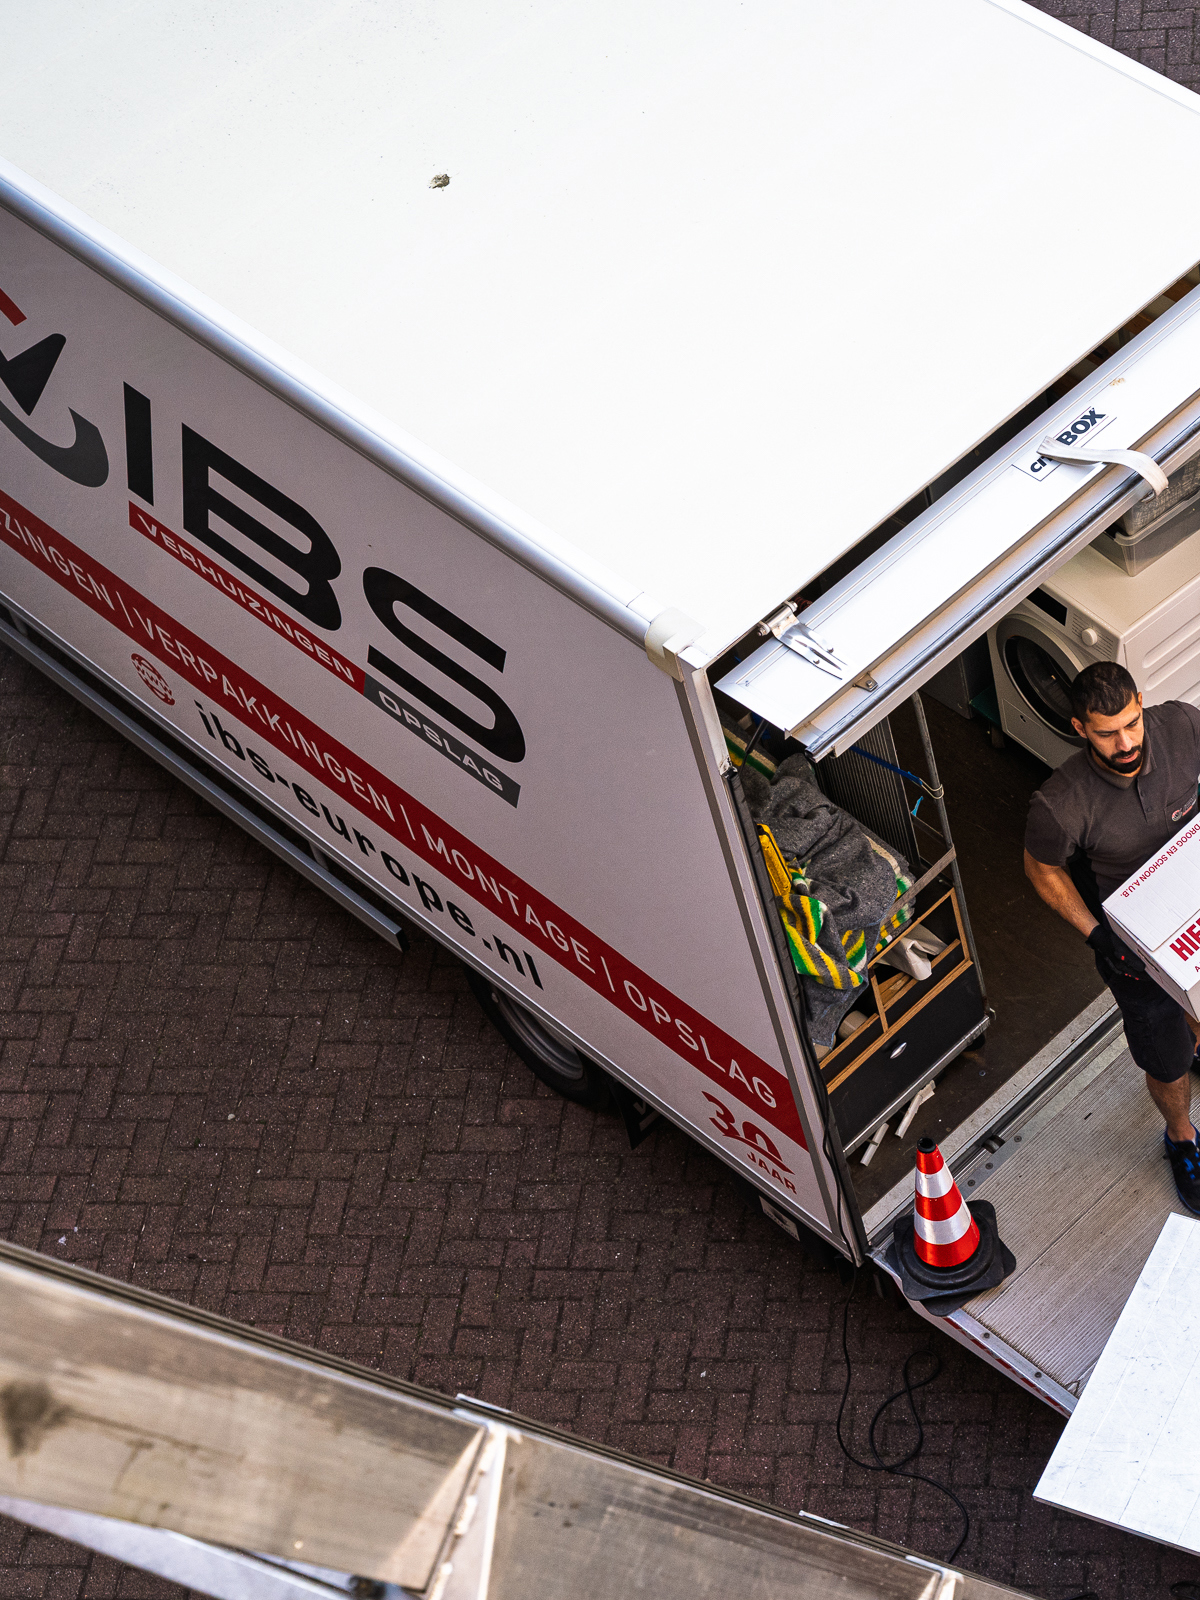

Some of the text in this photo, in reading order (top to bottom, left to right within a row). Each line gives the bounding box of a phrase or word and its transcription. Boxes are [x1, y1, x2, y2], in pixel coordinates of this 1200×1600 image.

[1056, 407, 1106, 446] BOX
[123, 381, 526, 763] IBS
[137, 513, 504, 791] VERHUIZINGEN OPSLAG
[195, 699, 543, 990] ibs-europe.nl
[1166, 845, 1178, 856] EN
[1176, 824, 1199, 847] DROOG
[133, 607, 397, 820] VERPAKKINGEN
[421, 823, 596, 975] MONTAGE
[623, 980, 777, 1109] OPSLAG
[1139, 854, 1168, 881] SCHOON
[1120, 879, 1141, 898] A.U.B.
[747, 1152, 797, 1194] JAAR
